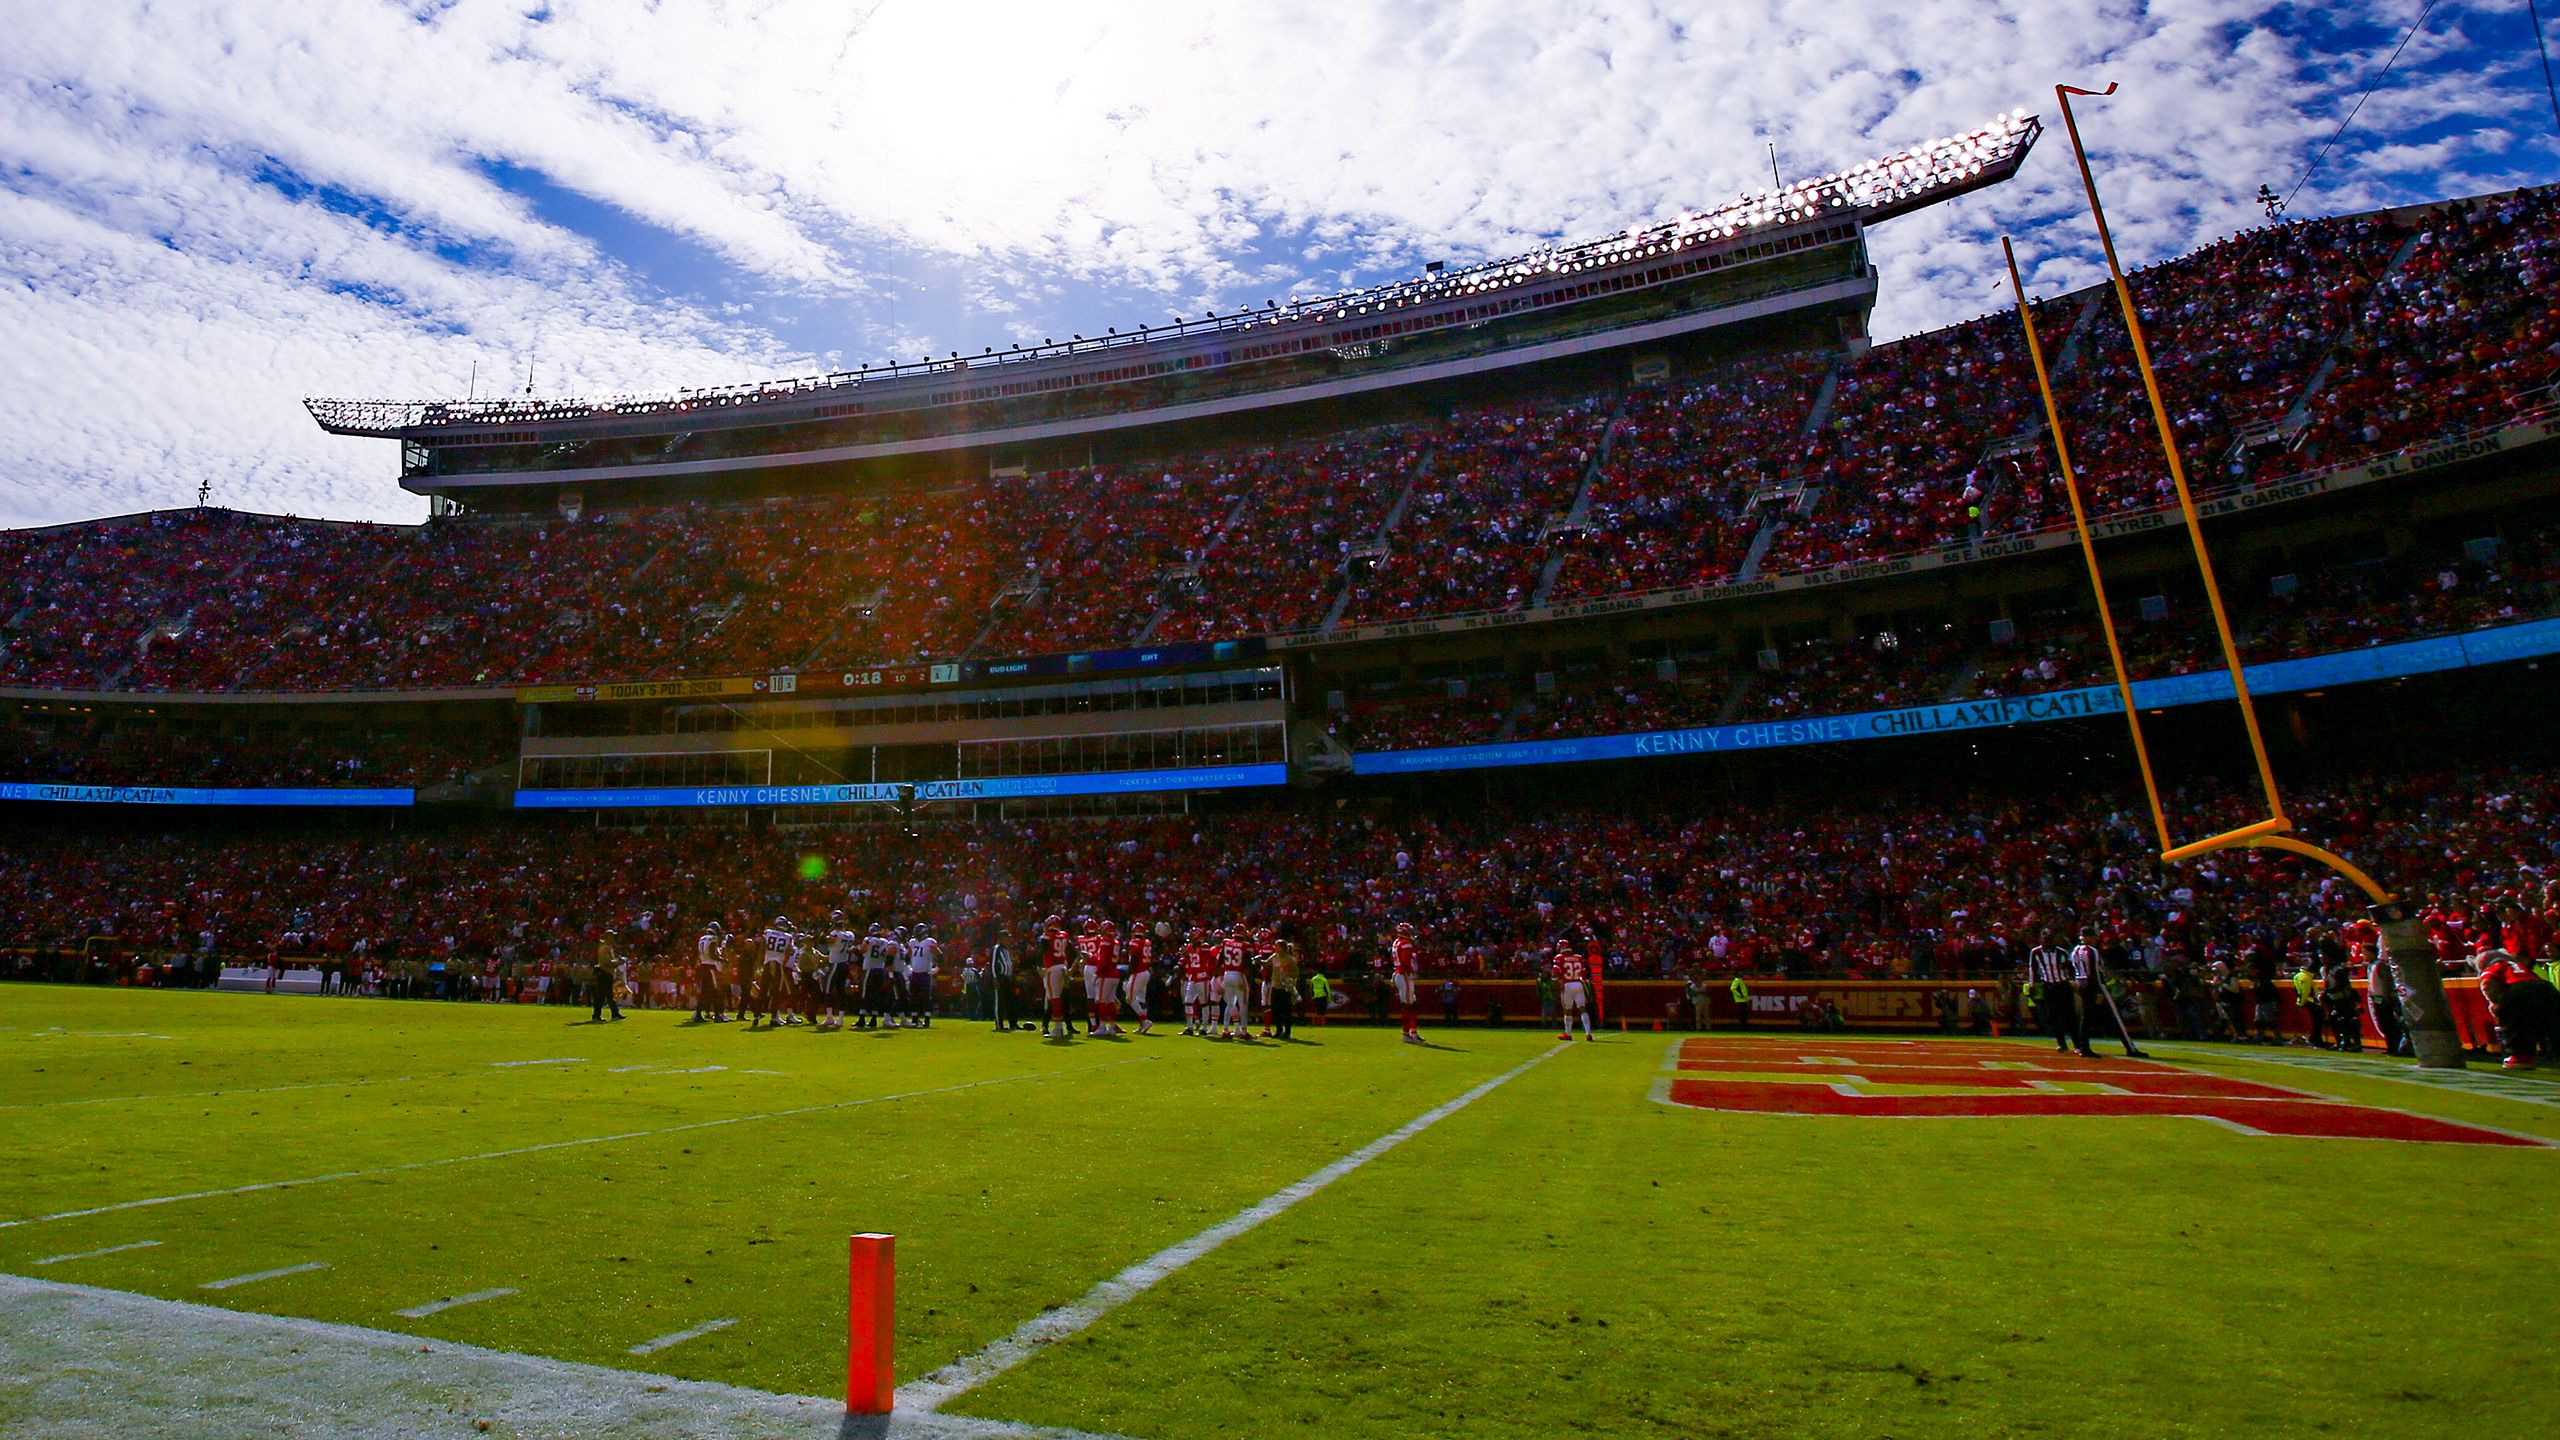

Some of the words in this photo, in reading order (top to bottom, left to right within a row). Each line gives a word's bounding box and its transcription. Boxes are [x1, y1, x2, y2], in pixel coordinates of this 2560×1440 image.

[2410, 437, 2500, 470] DAWSON
[2241, 478, 2326, 508] GARRETT
[2108, 515, 2165, 535] TYRER
[1943, 552, 1959, 564] 55
[1980, 538, 2035, 557] HOLUB
[1840, 560, 1912, 580] BURFORD
[1703, 579, 1775, 600] ROBINSON
[1582, 598, 1644, 615] ARBANAS
[1414, 622, 1440, 634] HILL
[1285, 634, 1325, 647] LAMAR
[1328, 630, 1359, 643] HUNT
[946, 666, 954, 681] 7
[1005, 663, 1028, 672] LIGHT
[772, 676, 783, 692] 10
[842, 671, 882, 687] 0:18
[609, 682, 656, 698] TODAY'S
[1635, 730, 1721, 754] KENNY
[1735, 718, 1858, 746] CHESNEY
[1399, 752, 1458, 766] ARROWHEAD
[1461, 749, 1502, 762] STADIUM
[697, 790, 750, 804] KENNY
[757, 787, 832, 803] CHESNEY
[767, 935, 787, 953] 82
[914, 945, 923, 957] 71
[1223, 946, 1243, 966] 53
[1563, 961, 1582, 981] 32
[1749, 995, 1785, 1012] HIS
